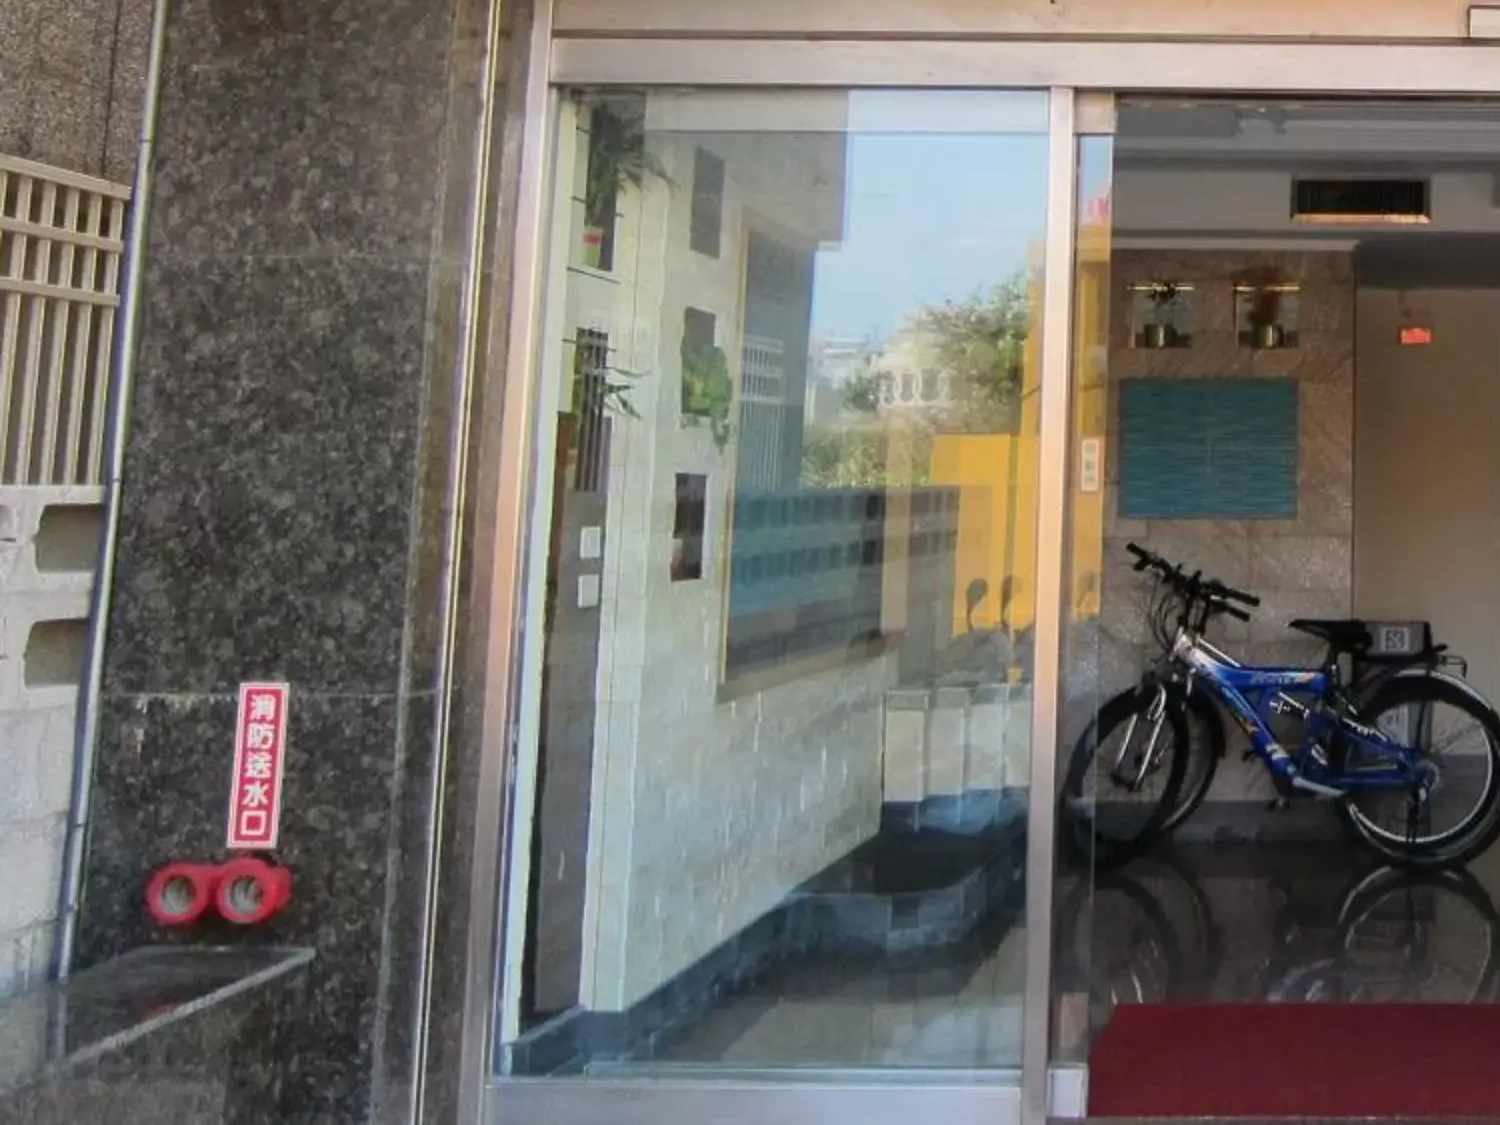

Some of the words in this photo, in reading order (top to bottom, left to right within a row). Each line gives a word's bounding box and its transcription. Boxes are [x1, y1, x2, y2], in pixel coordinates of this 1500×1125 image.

[240, 694, 275, 836] 消防送水口
